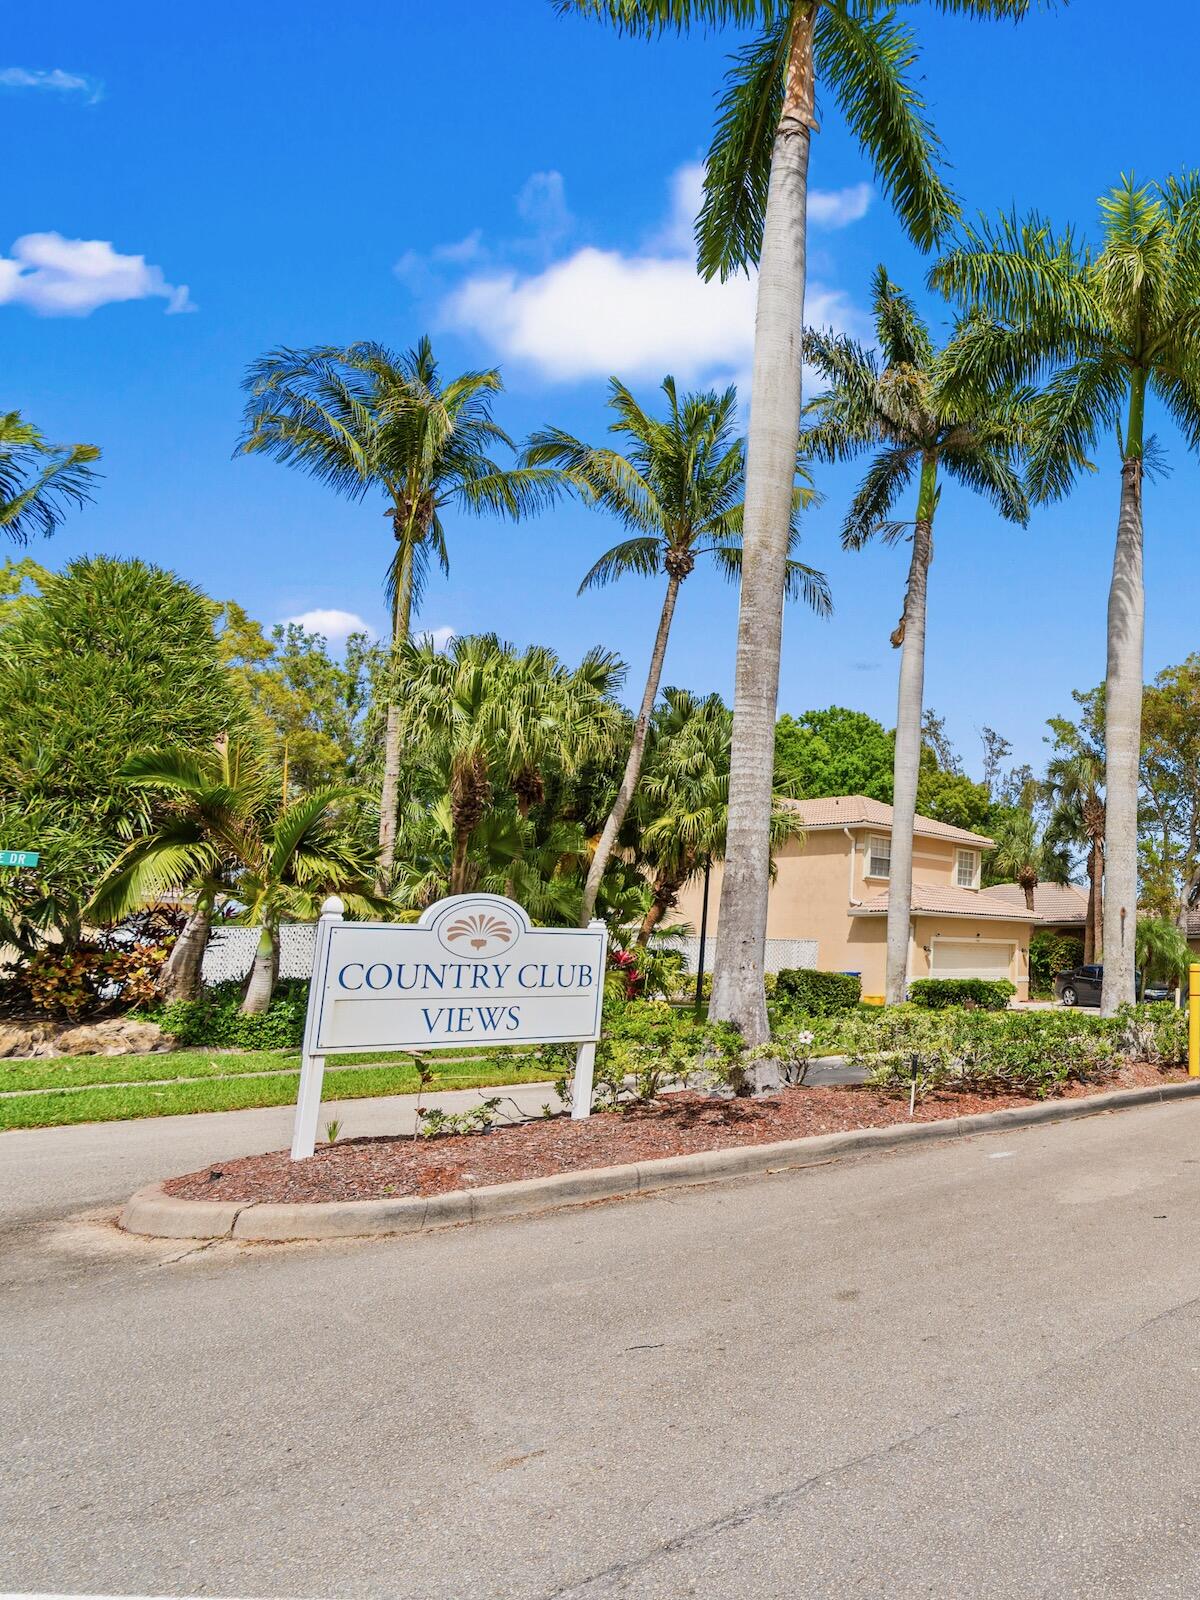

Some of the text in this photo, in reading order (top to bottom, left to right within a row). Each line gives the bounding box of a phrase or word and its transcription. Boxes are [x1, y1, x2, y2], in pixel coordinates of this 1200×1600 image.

[9, 853, 26, 865] DR
[337, 963, 594, 991] COUNTRY CLUB
[420, 1005, 519, 1034] VIEWS
